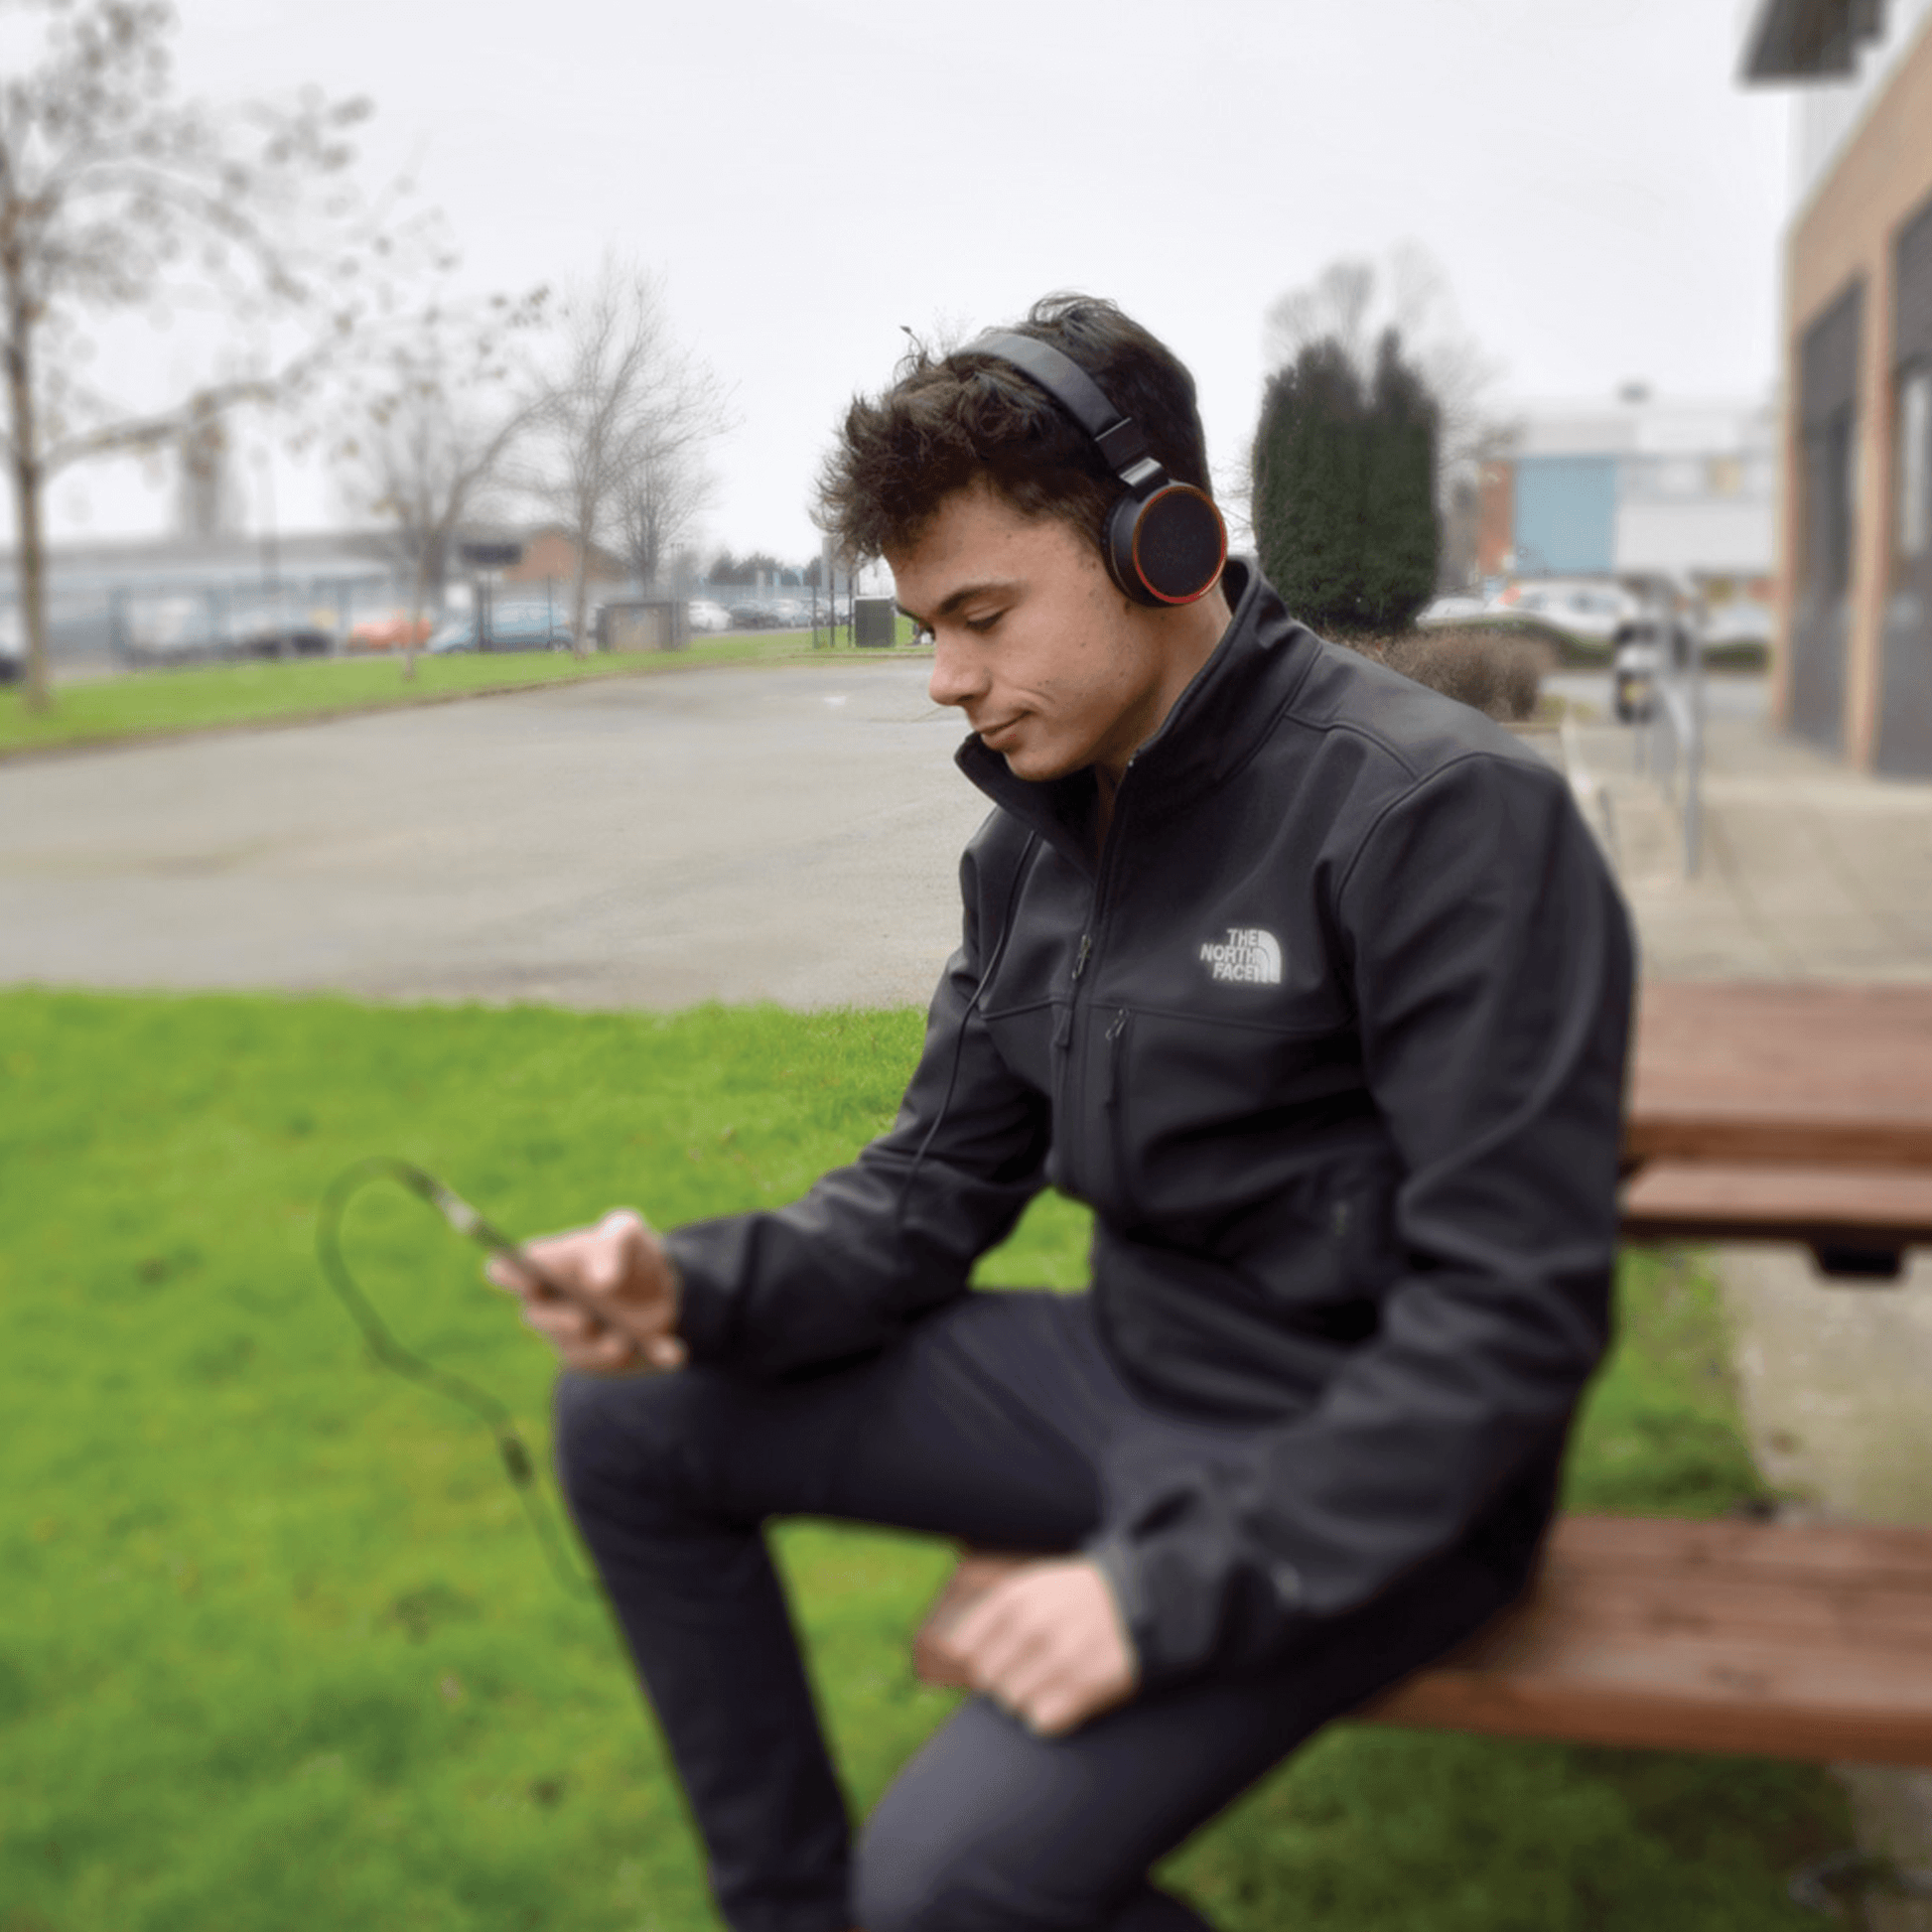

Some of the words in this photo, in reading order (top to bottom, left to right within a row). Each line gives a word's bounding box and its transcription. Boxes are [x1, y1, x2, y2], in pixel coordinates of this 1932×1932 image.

[1227, 928, 1258, 946] THE
[1199, 943, 1256, 964] NORTH
[1212, 962, 1253, 981] FACE
